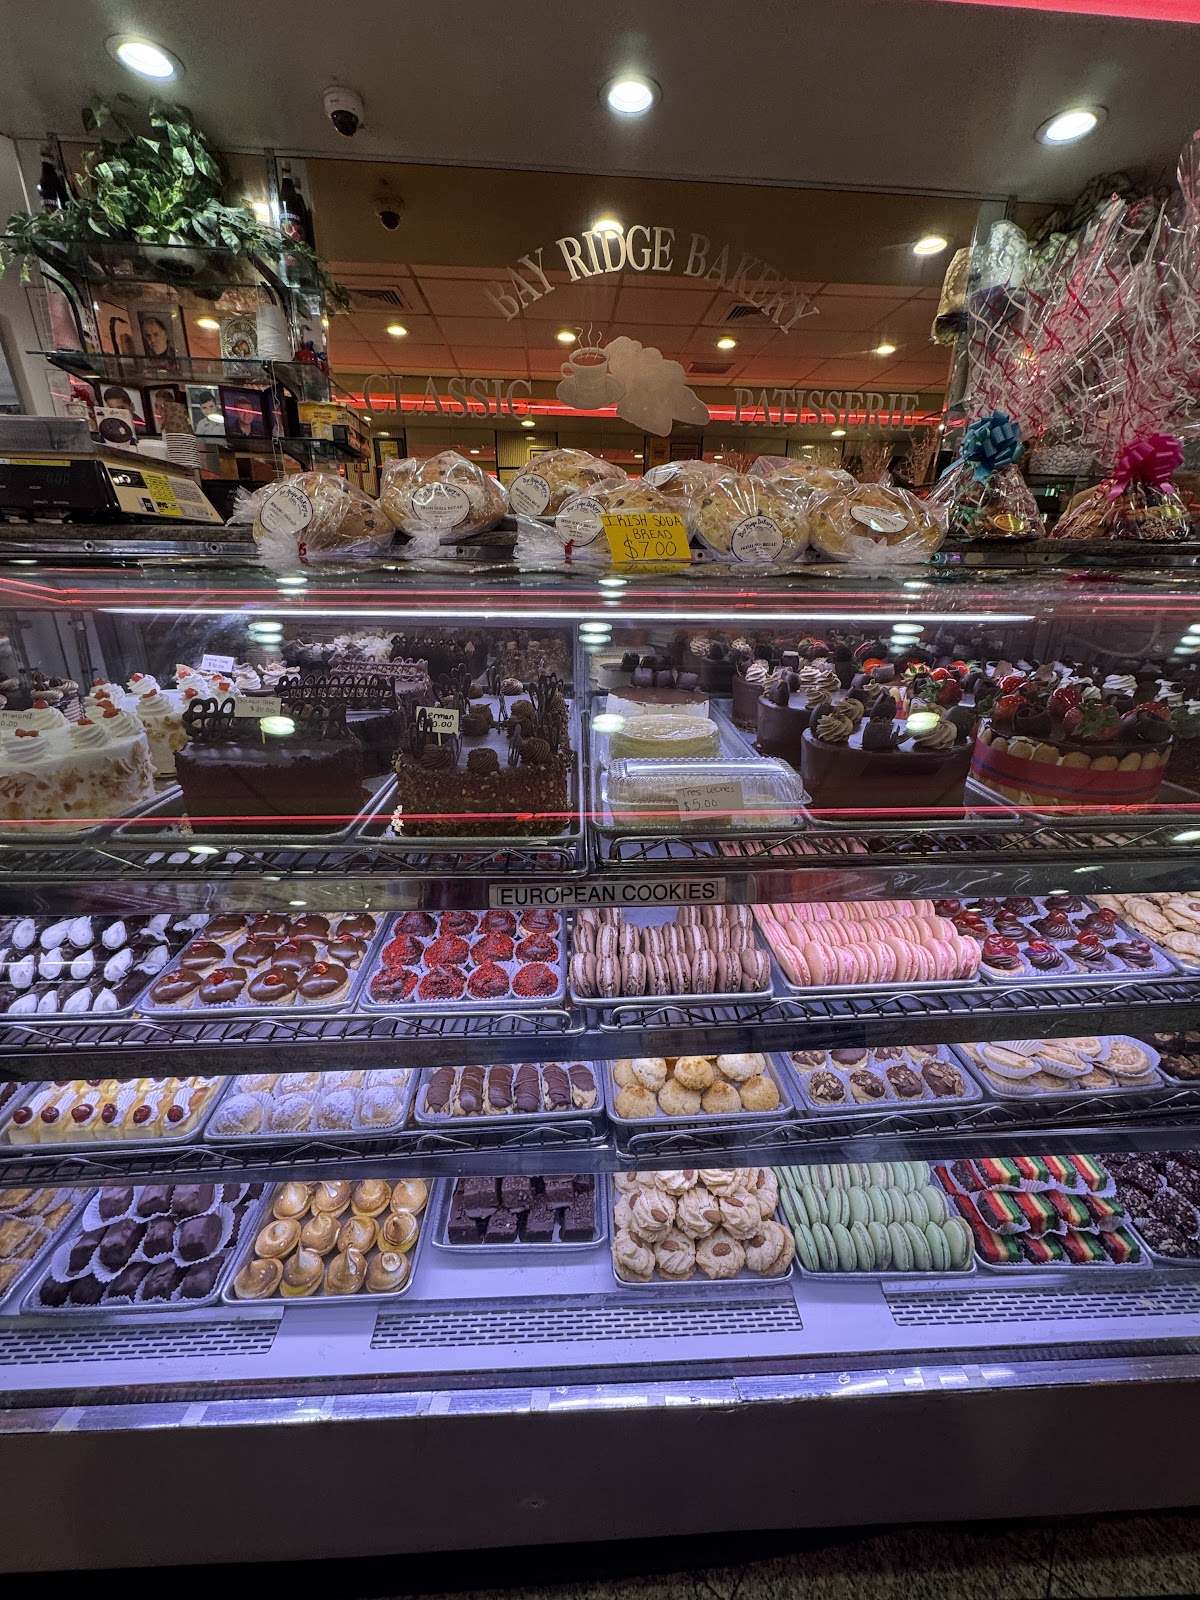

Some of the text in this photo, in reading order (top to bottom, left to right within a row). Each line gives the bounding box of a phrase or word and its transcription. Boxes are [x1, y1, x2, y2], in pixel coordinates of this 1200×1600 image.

[483, 225, 820, 334] BAY RIDGE BAKERY
[363, 374, 532, 421] CLASSIC
[731, 388, 919, 431] PATISSERIE
[601, 514, 684, 527] IRISH SODA
[632, 528, 673, 540] BREAD
[623, 534, 677, 560] $7.00
[427, 711, 455, 720] erman
[677, 786, 702, 797] Tres
[683, 798, 718, 812] $5.00
[500, 882, 716, 905] EUROPEAN COOKIES
